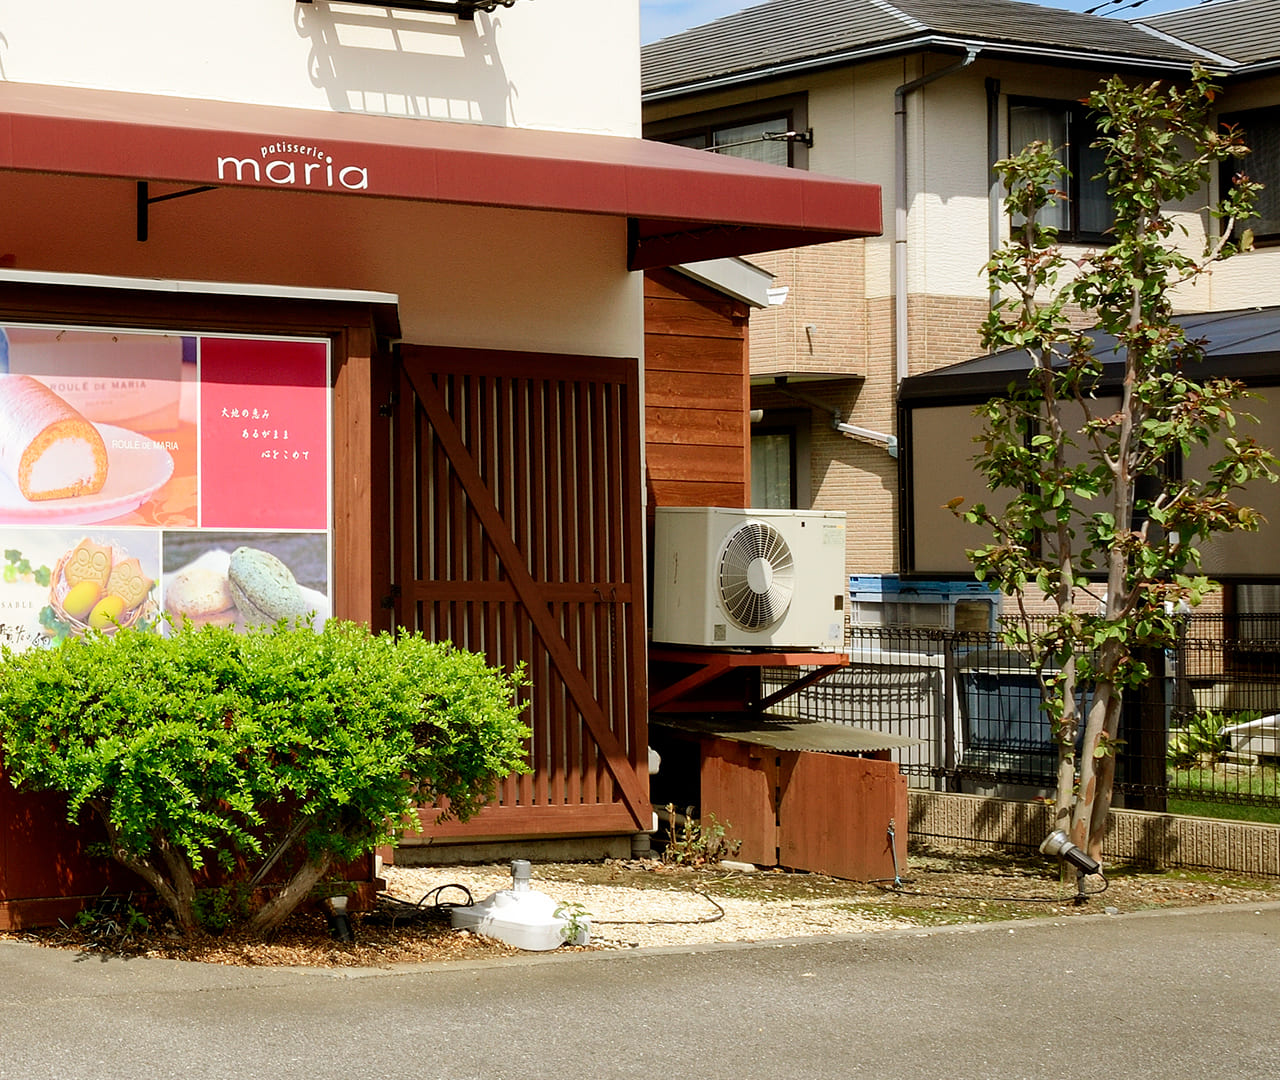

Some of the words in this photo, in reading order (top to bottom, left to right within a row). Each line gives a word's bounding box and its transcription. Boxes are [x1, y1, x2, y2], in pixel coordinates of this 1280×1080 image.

[260, 141, 324, 159] patisserie
[217, 156, 369, 190] maria
[111, 380, 147, 389] MARIA
[153, 440, 179, 451] MARIA
